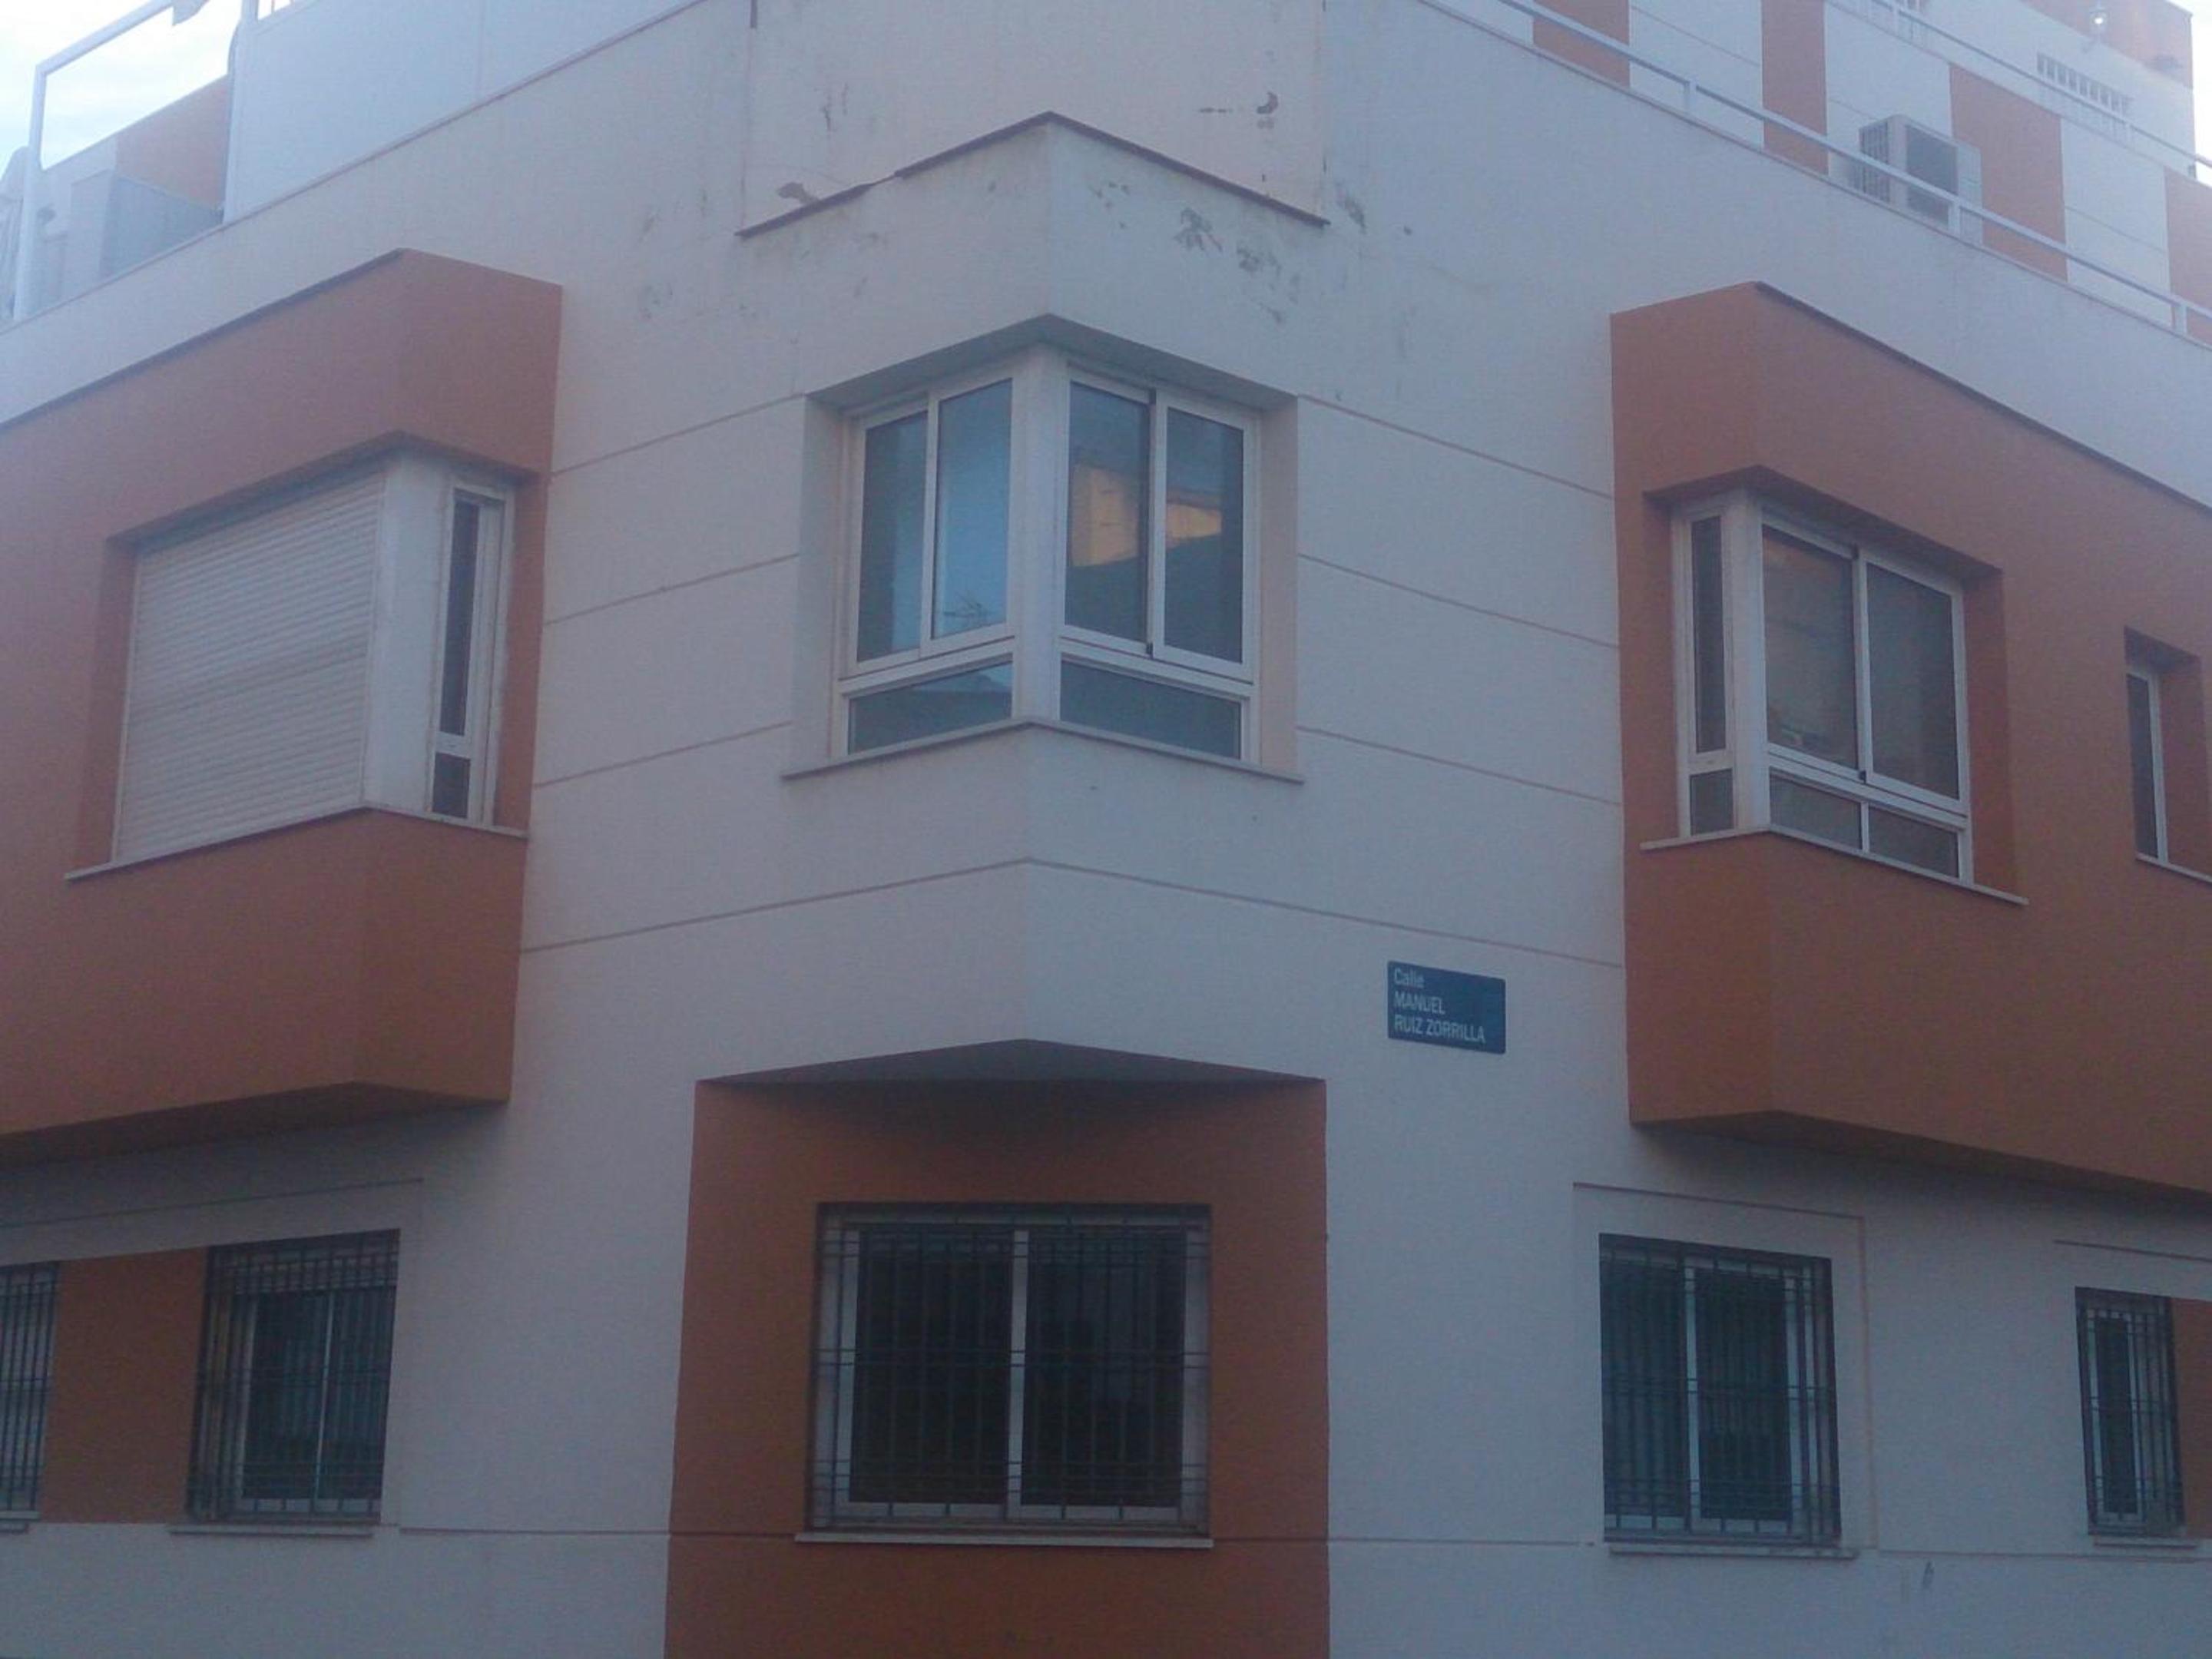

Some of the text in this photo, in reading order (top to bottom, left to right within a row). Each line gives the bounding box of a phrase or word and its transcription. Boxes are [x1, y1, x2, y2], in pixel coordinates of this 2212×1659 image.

[1394, 968, 1425, 988] Calle
[1393, 991, 1445, 1015] MANUEL
[1394, 1014, 1486, 1044] RUIZ ZORRILLA
